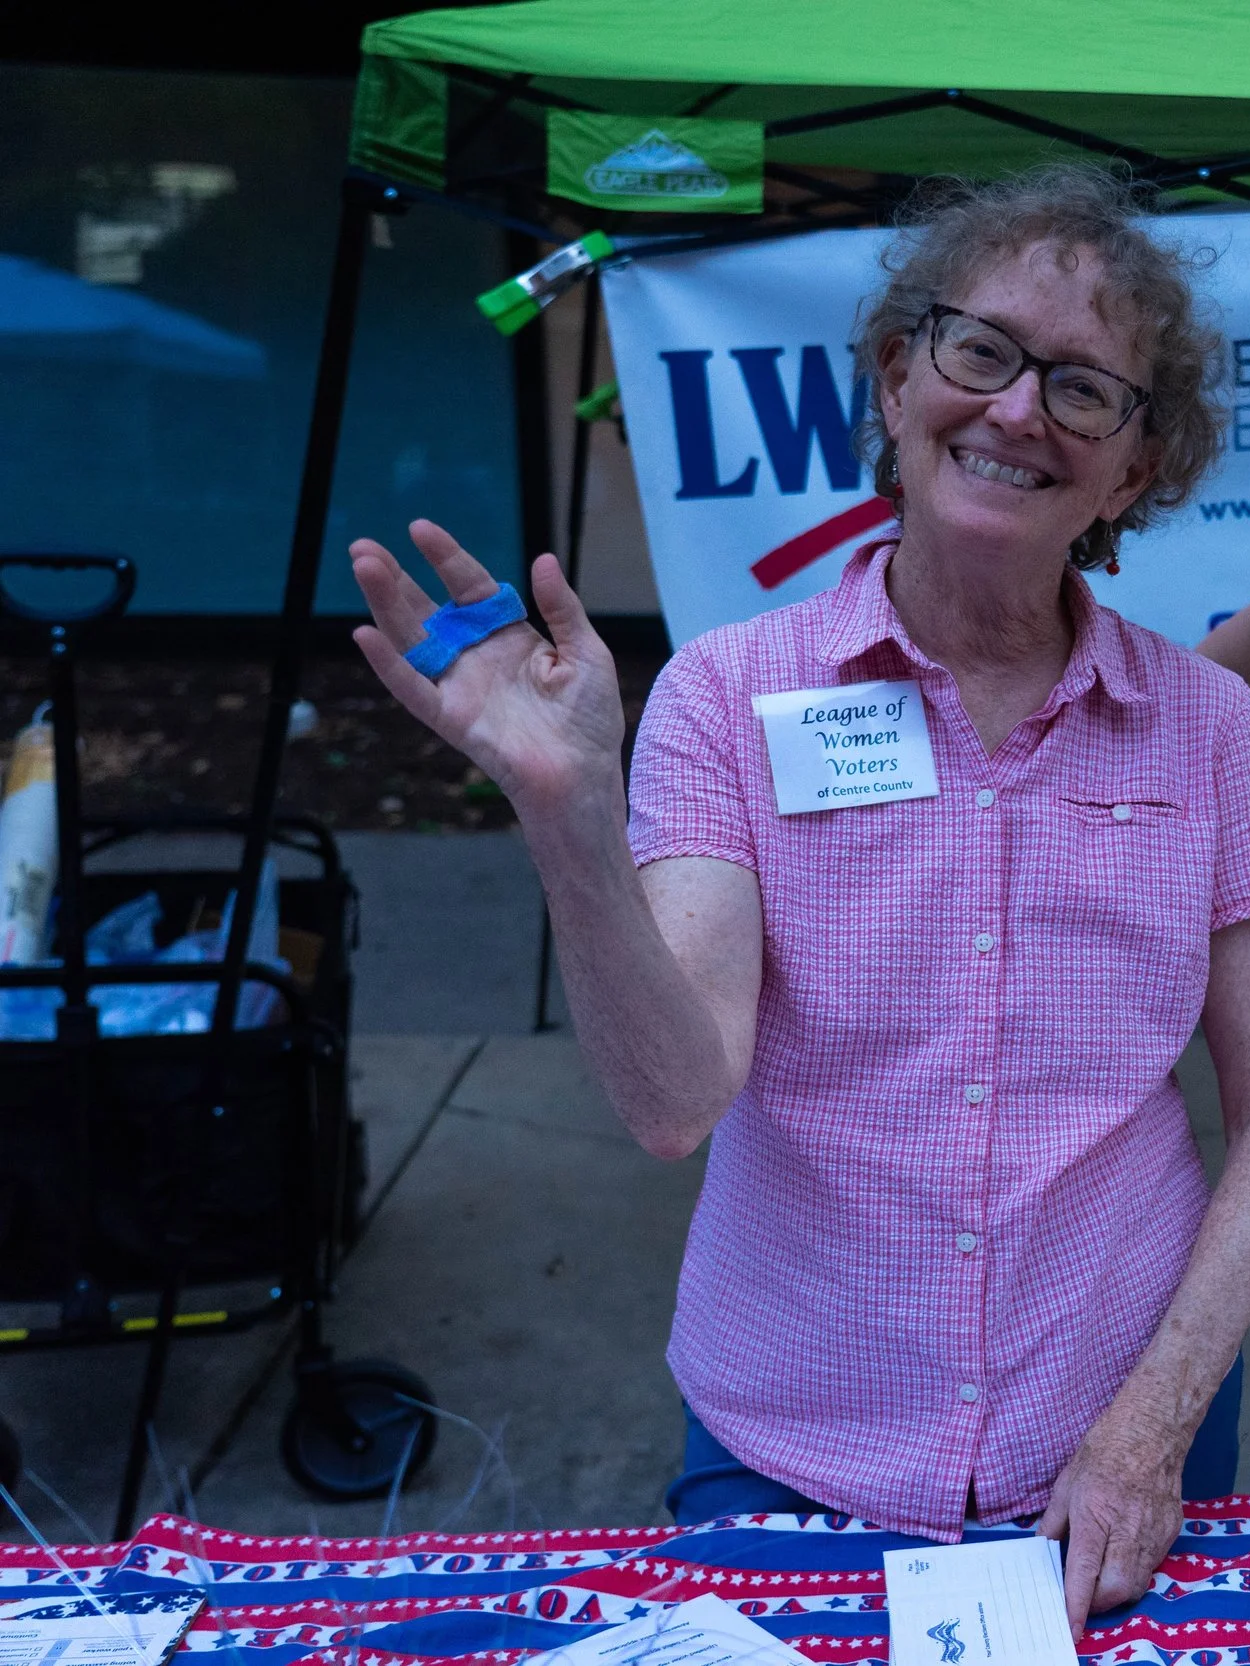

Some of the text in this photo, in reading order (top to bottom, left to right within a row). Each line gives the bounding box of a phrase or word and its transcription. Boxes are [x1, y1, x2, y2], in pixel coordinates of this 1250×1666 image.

[801, 696, 908, 727] League of
[815, 730, 901, 750] Women
[825, 757, 898, 777] Voters
[817, 780, 913, 799] of Centre County
[208, 1561, 352, 1583] VOTE
[407, 1552, 552, 1574] VOTE
[983, 1638, 991, 1650] County
